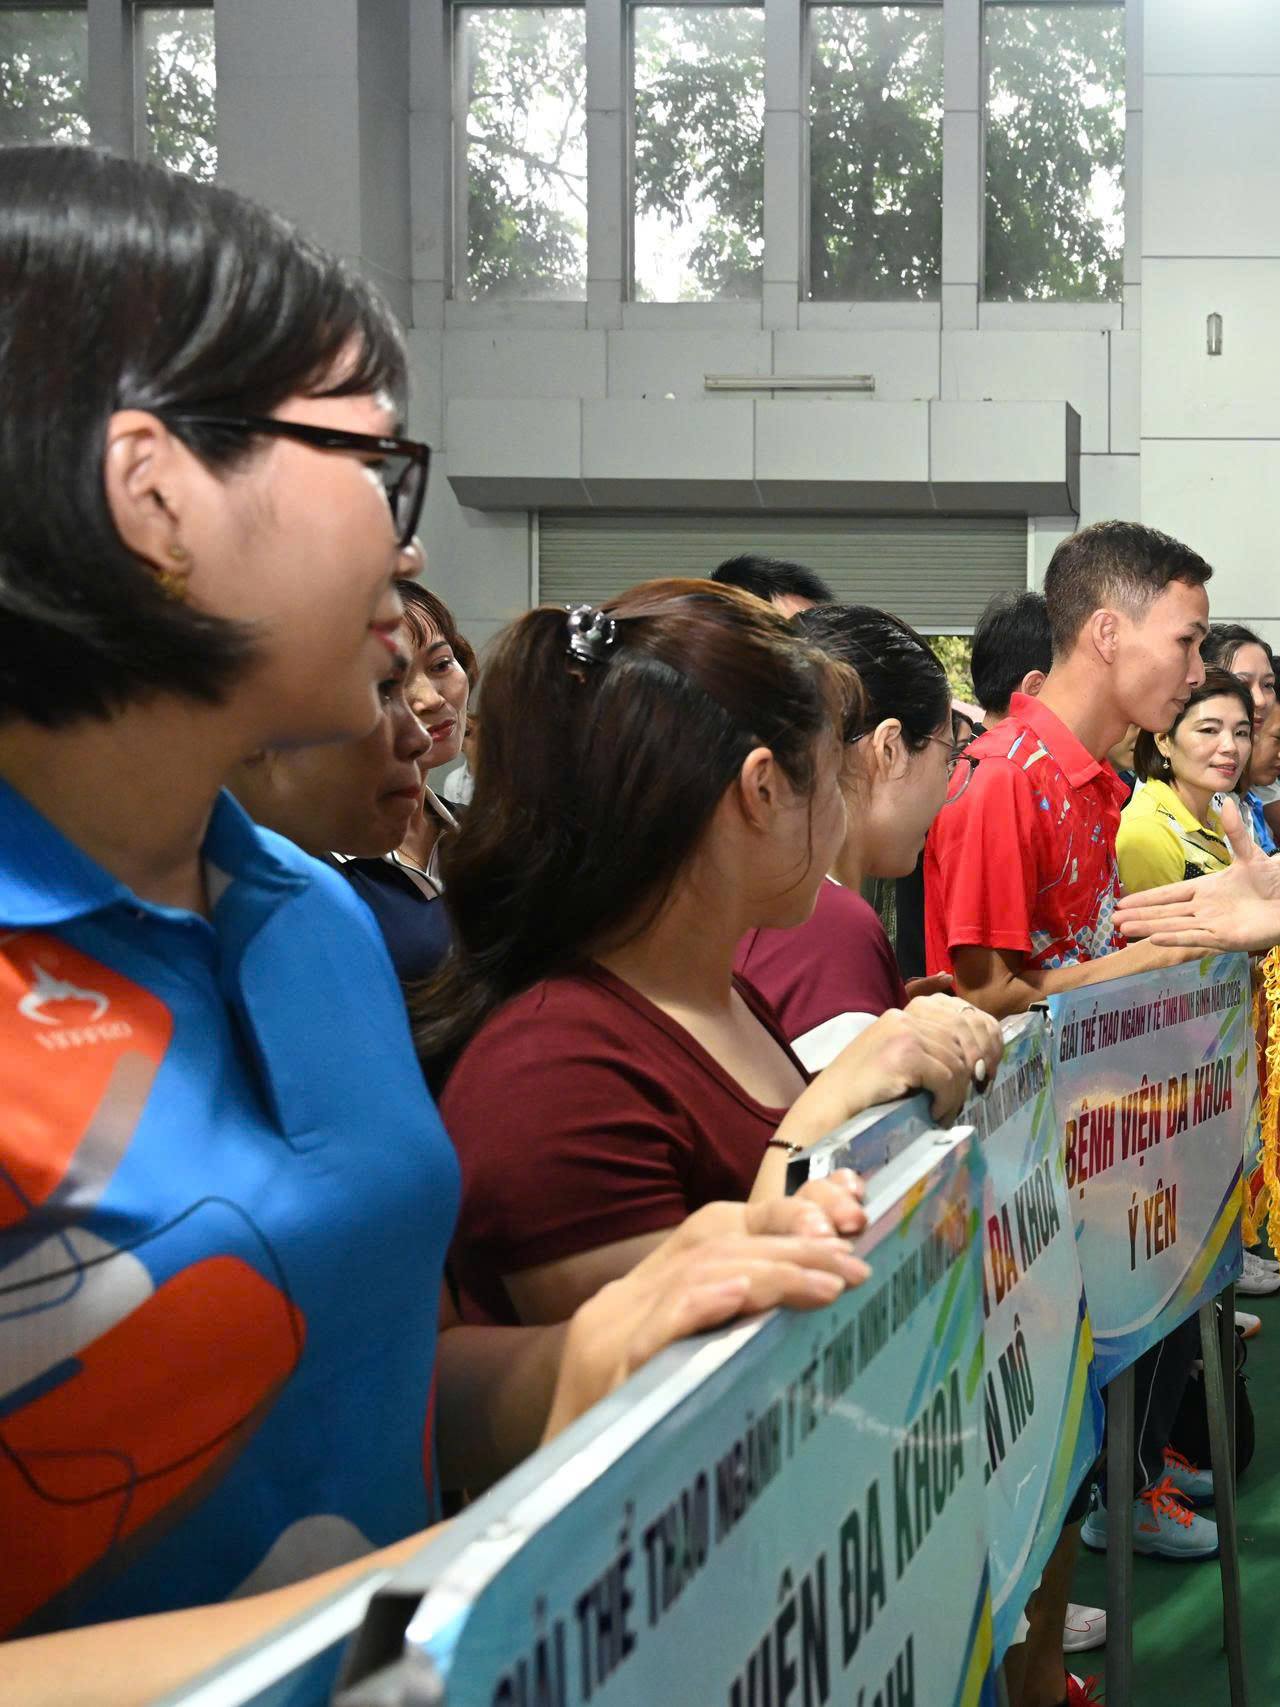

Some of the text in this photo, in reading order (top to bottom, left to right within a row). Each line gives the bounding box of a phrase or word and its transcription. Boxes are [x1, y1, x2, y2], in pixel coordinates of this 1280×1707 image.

[1060, 1010, 1078, 1062] GIẢI
[1081, 1001, 1098, 1056] THỂ
[1099, 1010, 1119, 1050] THAO
[1147, 1003, 1153, 1033] Y
[1153, 991, 1163, 1031] TẾ
[1065, 1098, 1116, 1200] BỆNH
[1121, 1074, 1163, 1167] VIỆN
[1165, 1072, 1188, 1139] ĐA
[1192, 1055, 1233, 1126] KHOA
[1014, 1158, 1061, 1273] KHOA
[1127, 1178, 1177, 1271] Ý YÊN
[998, 1312, 1035, 1444] MÔ
[839, 1478, 887, 1672] ĐA
[894, 1368, 965, 1581] KHOA
[575, 1500, 637, 1704] THỂ
[643, 1470, 710, 1630] THAO
